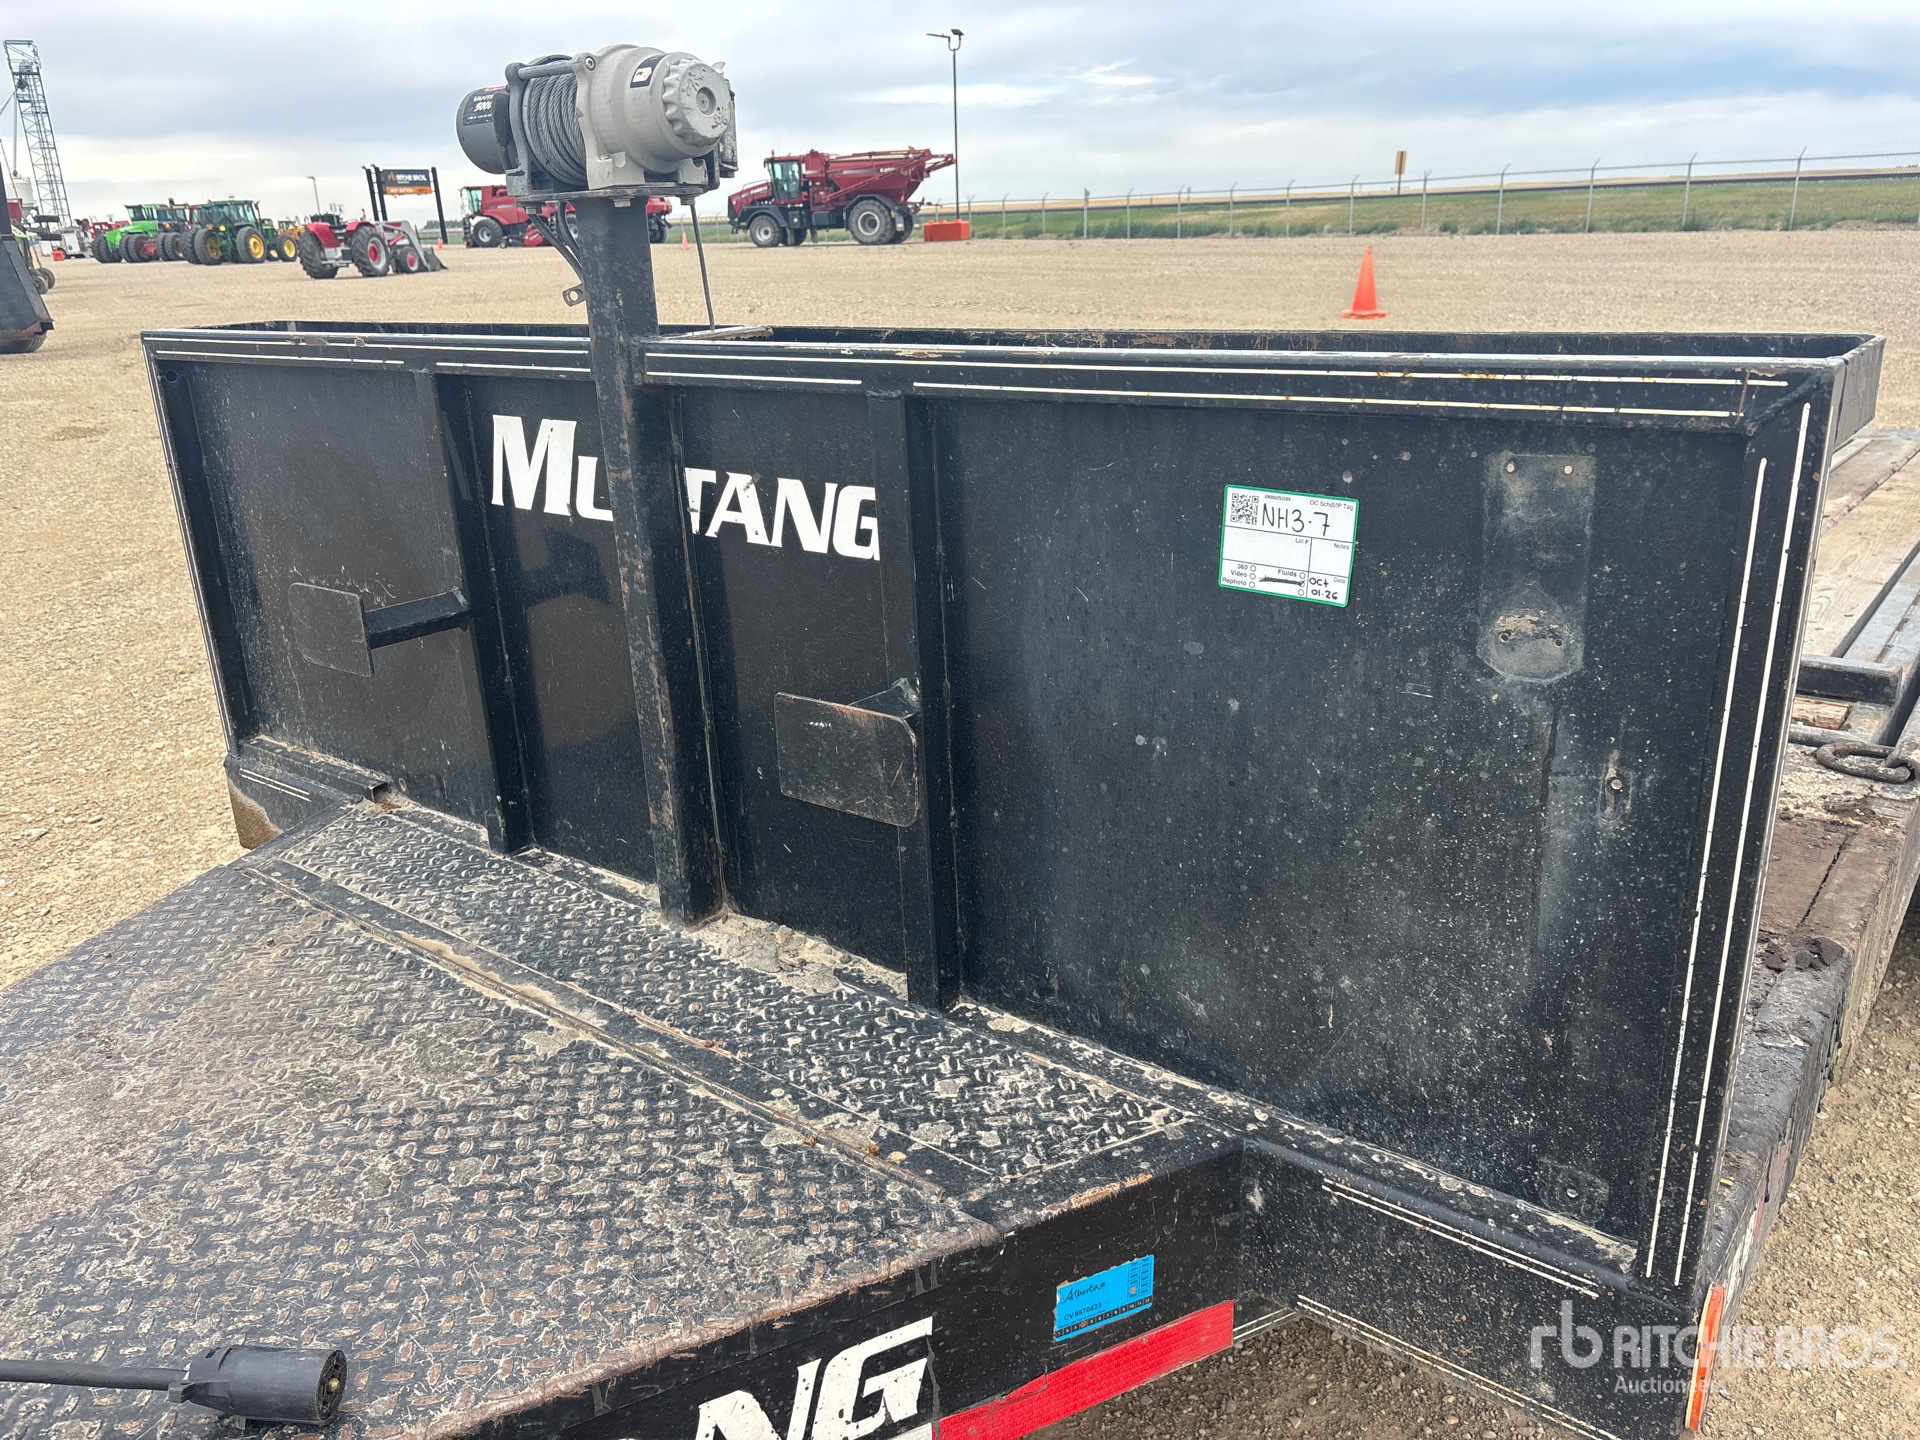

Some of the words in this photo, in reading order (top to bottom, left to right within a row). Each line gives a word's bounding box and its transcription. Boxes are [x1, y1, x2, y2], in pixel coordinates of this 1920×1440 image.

[491, 414, 880, 561] MUTANG
[1343, 503, 1354, 511] Tag
[1230, 569, 1248, 578] Video
[1277, 569, 1297, 578] Fluids
[1222, 576, 1247, 587] Rephoto
[1061, 1283, 1099, 1304] Alberta
